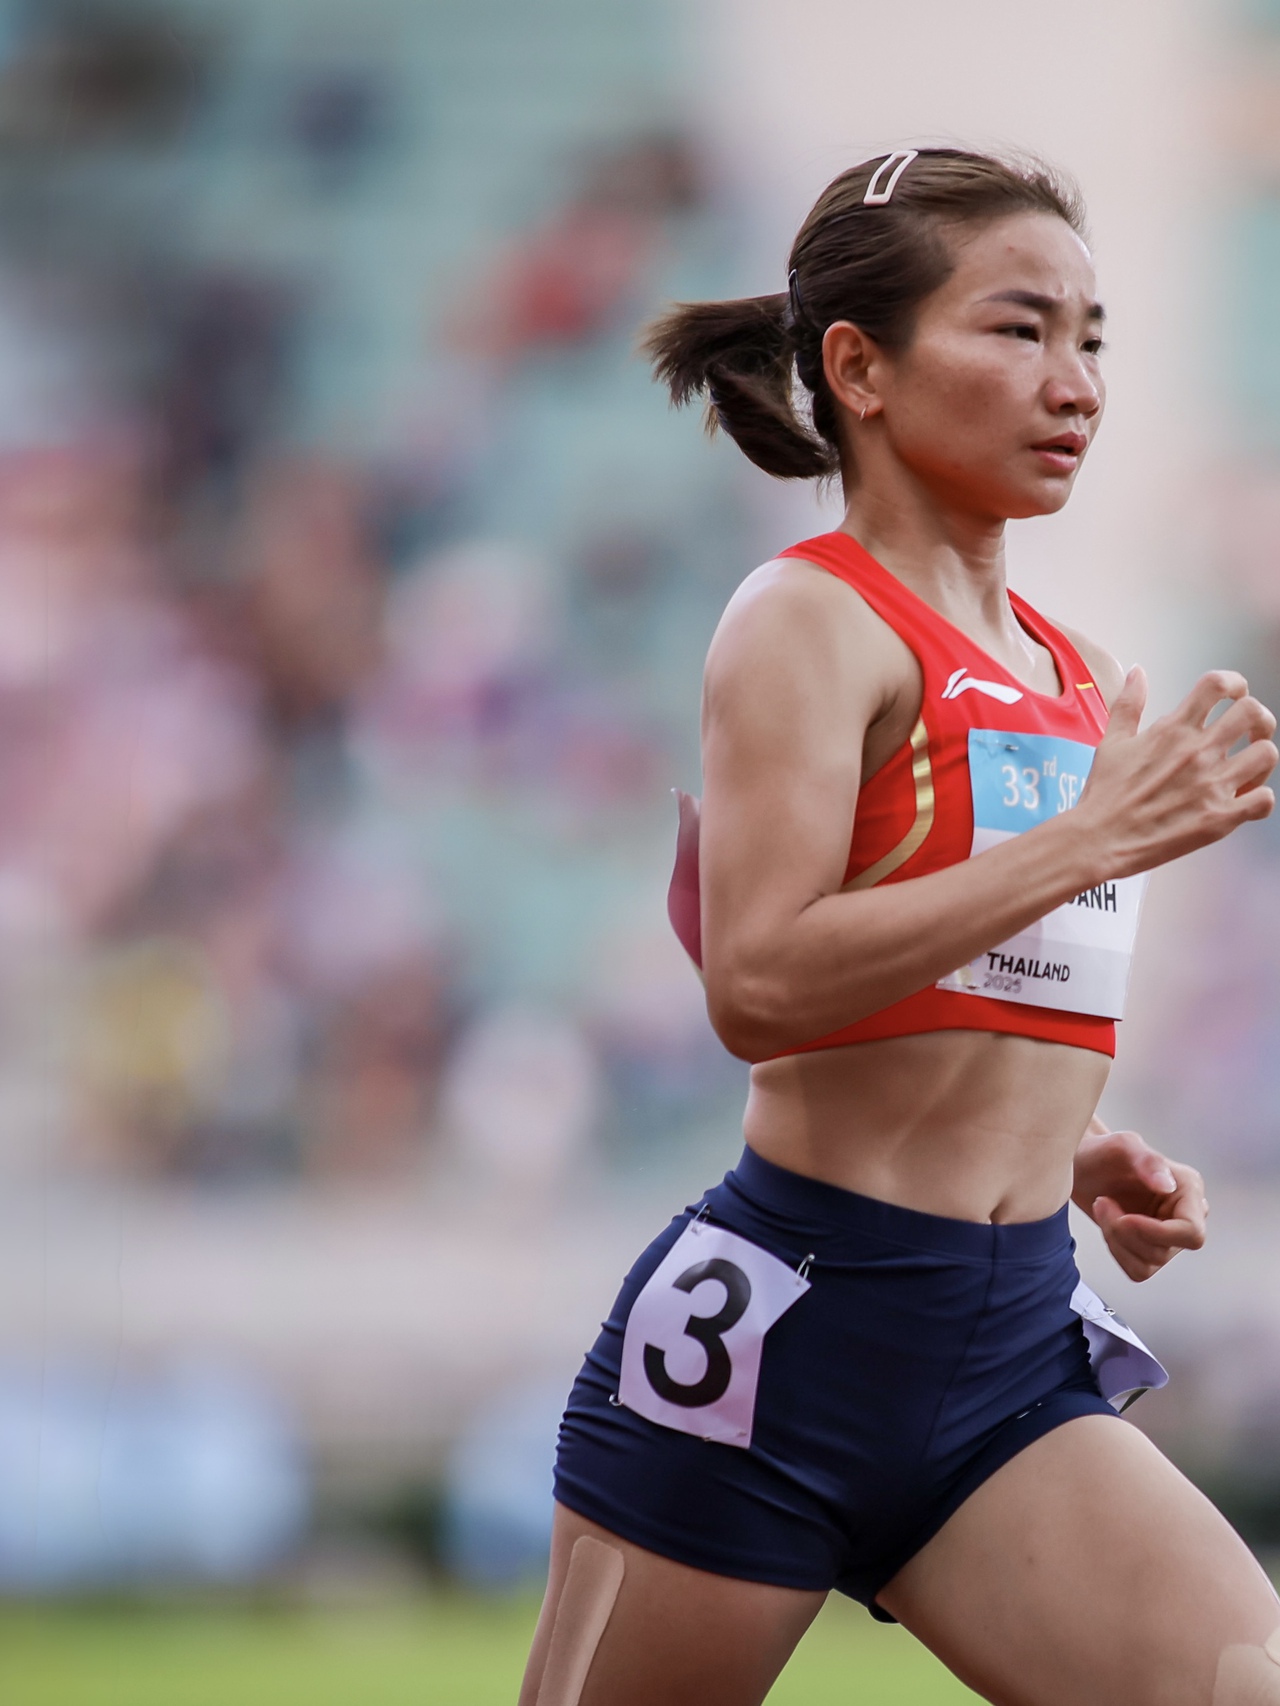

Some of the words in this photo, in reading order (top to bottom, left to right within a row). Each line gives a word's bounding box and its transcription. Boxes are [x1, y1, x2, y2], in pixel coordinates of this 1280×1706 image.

[1057, 772, 1087, 814] SE
[1066, 882, 1117, 913] ANH
[986, 952, 1070, 982] THAILAND
[983, 973, 1022, 993] 2025
[643, 1258, 752, 1409] 3
